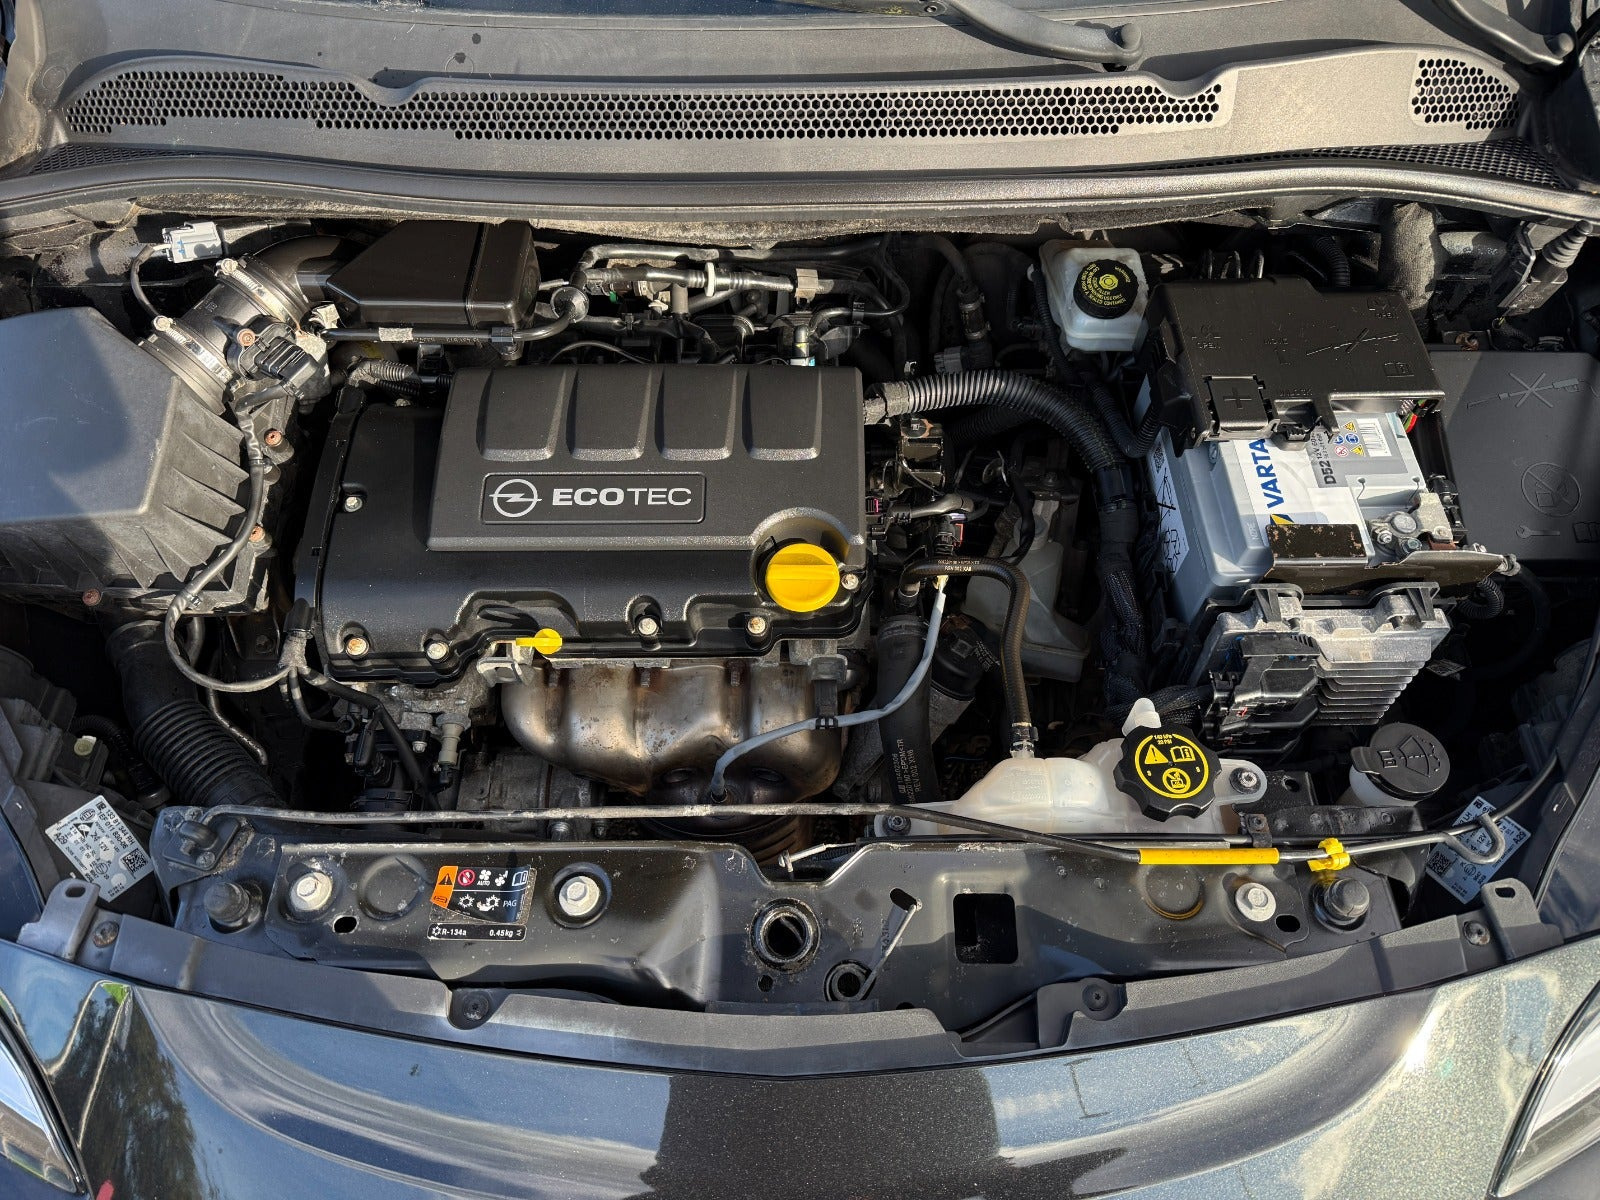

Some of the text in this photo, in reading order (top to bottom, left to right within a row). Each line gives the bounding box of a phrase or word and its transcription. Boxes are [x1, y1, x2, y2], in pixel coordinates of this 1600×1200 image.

[1248, 438, 1285, 509] VARTA
[1319, 460, 1337, 485] D52
[552, 487, 692, 506] ECOTEC
[1476, 832, 1487, 844] 12V
[1512, 831, 1527, 845] A29
[503, 900, 517, 908] PAG
[441, 928, 514, 938] R-134a 0.45kg
